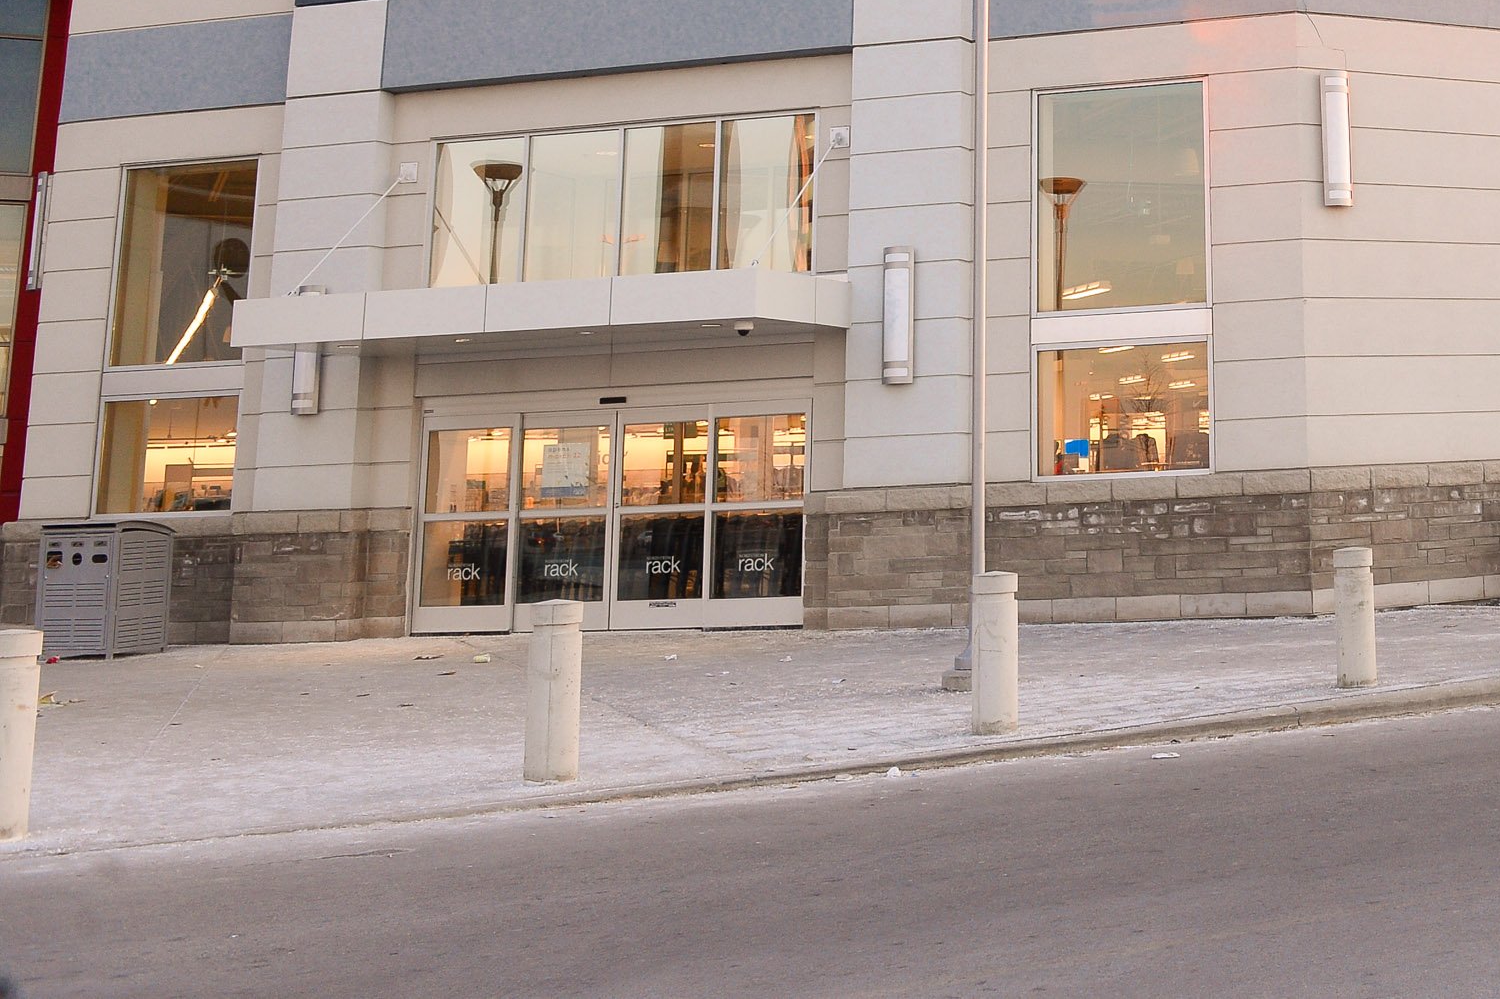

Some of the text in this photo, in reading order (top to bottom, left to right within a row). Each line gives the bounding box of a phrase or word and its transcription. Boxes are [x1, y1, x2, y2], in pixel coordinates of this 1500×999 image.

[447, 562, 481, 581] rack
[544, 558, 579, 577] rack
[646, 555, 681, 574] rack
[738, 553, 775, 572] rack
